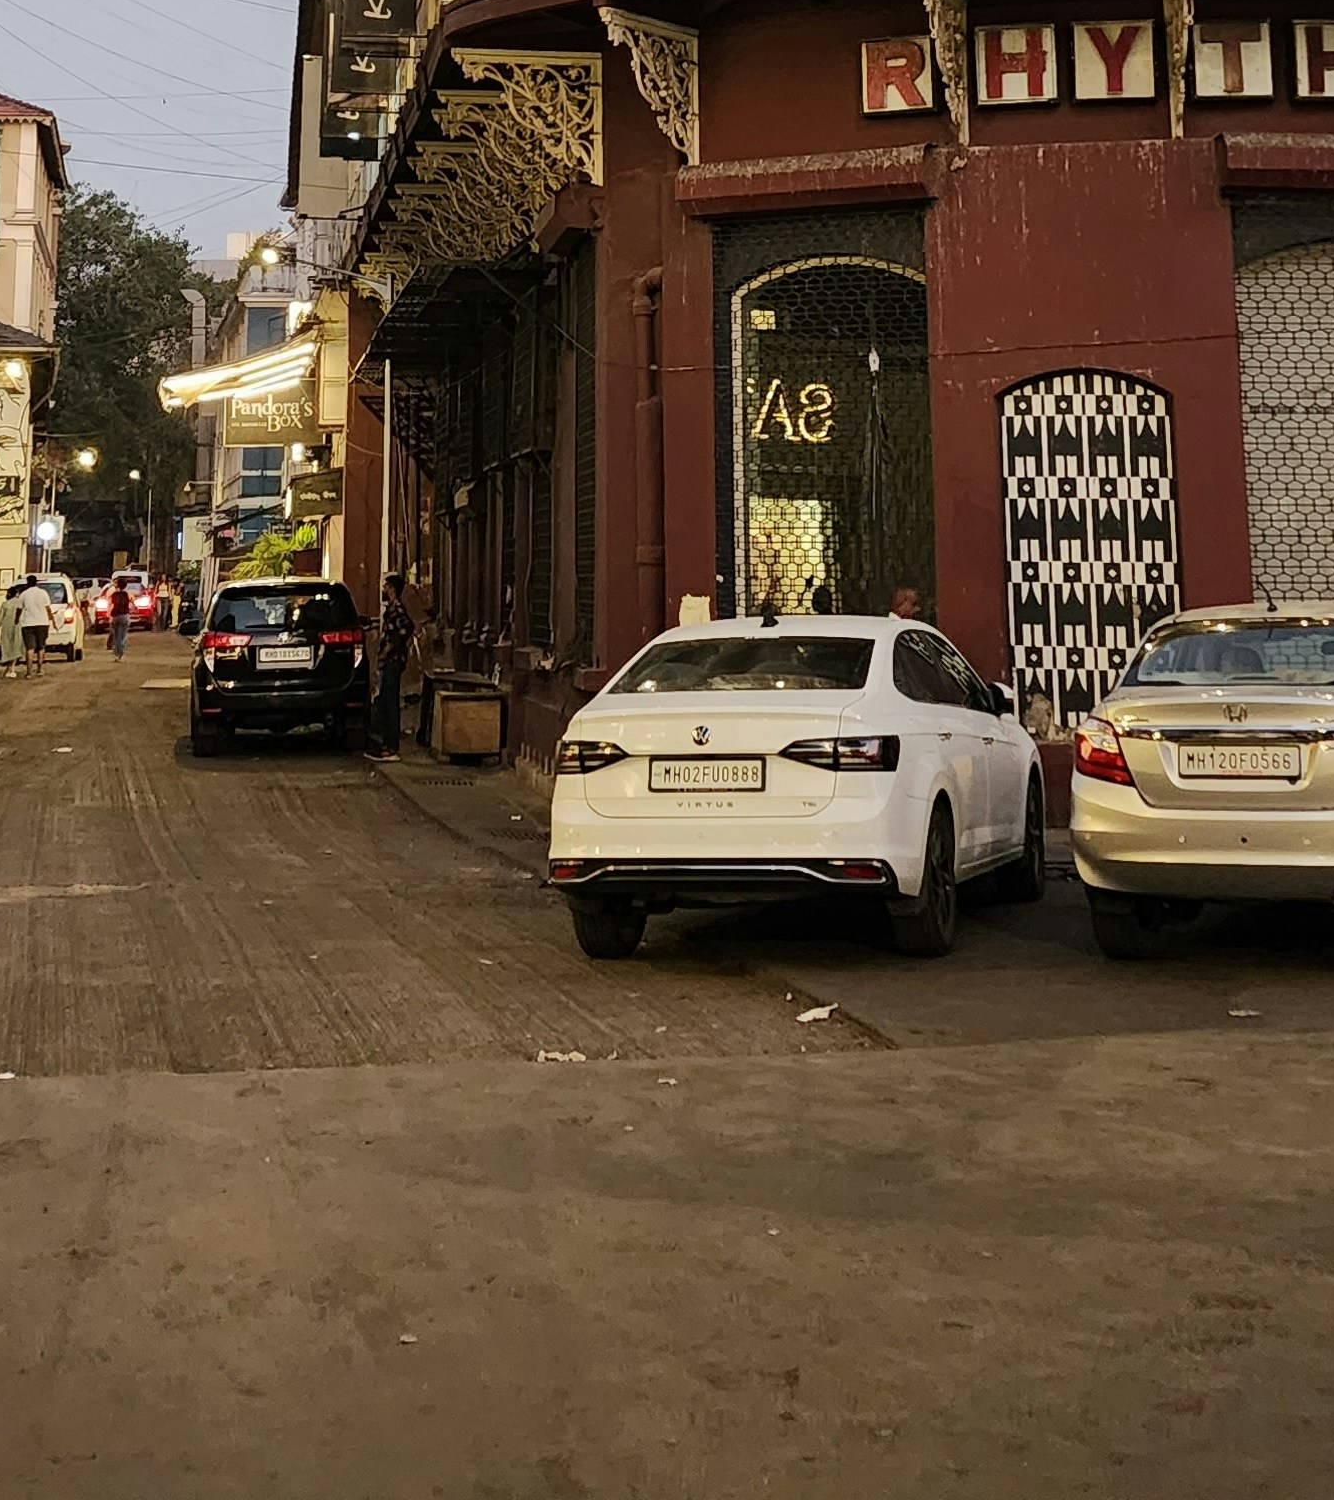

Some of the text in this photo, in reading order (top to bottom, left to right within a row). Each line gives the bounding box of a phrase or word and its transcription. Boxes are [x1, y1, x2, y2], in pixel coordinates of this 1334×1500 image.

[230, 393, 313, 419] Pandora's
[663, 765, 760, 784] MH02FU0888
[676, 801, 735, 809] VIRTUS
